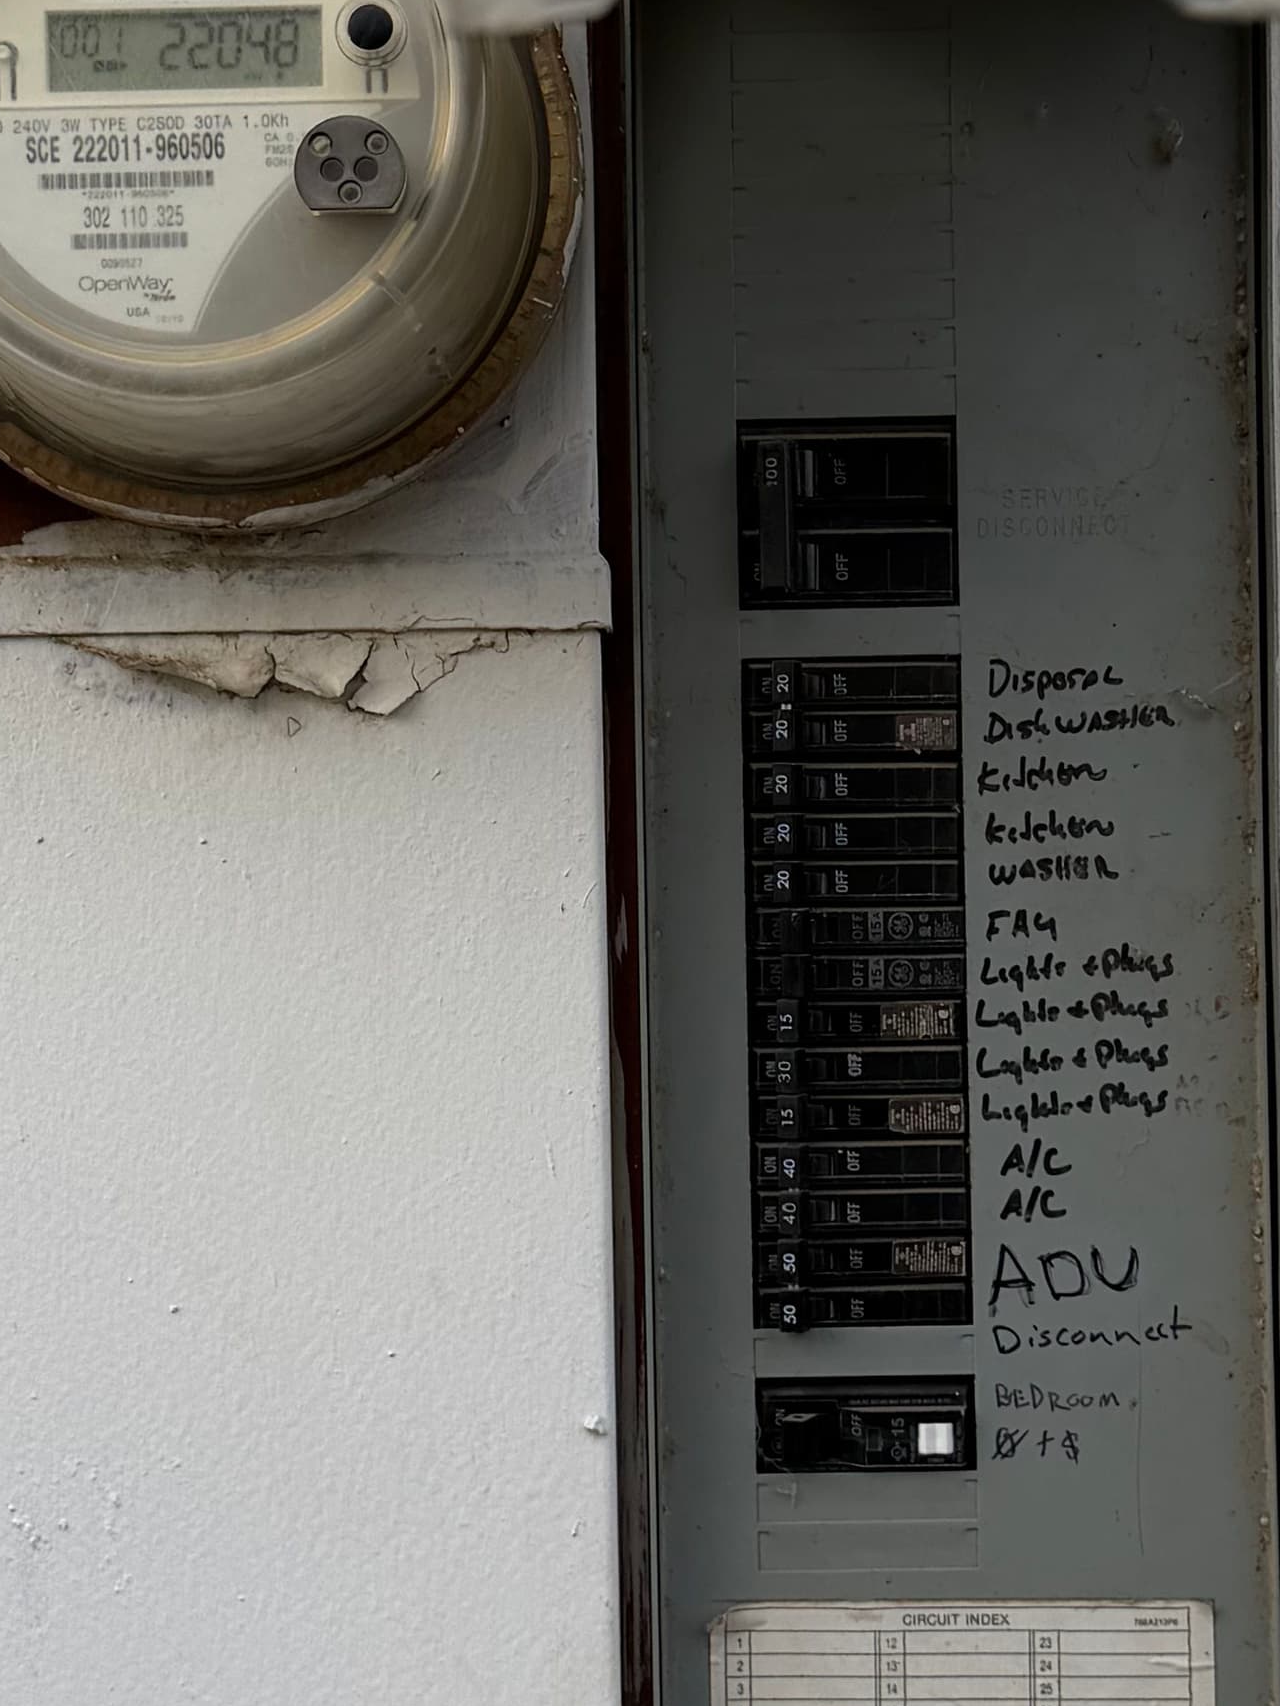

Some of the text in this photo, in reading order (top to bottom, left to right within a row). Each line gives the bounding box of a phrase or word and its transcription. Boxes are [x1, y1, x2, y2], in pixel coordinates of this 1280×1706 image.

[159, 18, 299, 71] 22048
[13, 119, 51, 134] 240V
[61, 119, 81, 133] 3W
[90, 117, 126, 132] TYPE
[194, 115, 232, 129] 30TA
[243, 114, 289, 129] 1.0Kh
[25, 132, 225, 163] SCE 222011-960506
[264, 133, 279, 142] CA
[83, 204, 184, 228] 302 110 325
[78, 275, 170, 293] OpenWay
[833, 459, 847, 485] OFF
[1001, 487, 1107, 509] SERVICE
[977, 514, 1129, 539] DISCONNECT
[834, 552, 849, 581] OFF
[777, 674, 790, 693] 20
[834, 673, 848, 695] OFF
[776, 719, 788, 739] 20
[834, 719, 848, 742] OFF
[776, 774, 788, 794] 20
[835, 773, 848, 796] OFF
[777, 823, 791, 843] 20
[835, 822, 848, 846] OFF
[777, 870, 790, 889] 20
[835, 869, 849, 893] OFF
[852, 914, 864, 940] OFF
[852, 960, 864, 987] OFF
[780, 1013, 792, 1031] 15
[849, 1010, 863, 1032] OFF
[778, 1061, 791, 1083] 30
[848, 1053, 863, 1077] OFF
[781, 1108, 794, 1126] 15
[848, 1105, 864, 1126] OFF
[782, 1158, 796, 1179] 40
[847, 1150, 861, 1172] OFF
[1000, 1138, 1072, 1178] A/C
[781, 1202, 797, 1225] 40
[847, 1202, 861, 1224] OFF
[1000, 1185, 1067, 1222] A/C
[782, 1253, 796, 1273] 50
[850, 1247, 863, 1269] OFF
[988, 1243, 1140, 1307] ADU
[782, 1304, 797, 1325] 50
[851, 1297, 865, 1319] OFF
[992, 1304, 1193, 1354] Disconnect
[851, 1414, 864, 1437] OFF
[891, 1416, 905, 1437] 15
[902, 1613, 1010, 1626] CIRCUIT INDEX
[737, 1638, 742, 1649] 1
[886, 1637, 897, 1649] 12
[1040, 1638, 1052, 1648] 23
[737, 1661, 744, 1671] 2
[886, 1660, 897, 1671] 13
[1040, 1660, 1051, 1671] 24
[737, 1684, 744, 1695] 3
[886, 1684, 897, 1694] 14
[1040, 1684, 1052, 1694] 25
